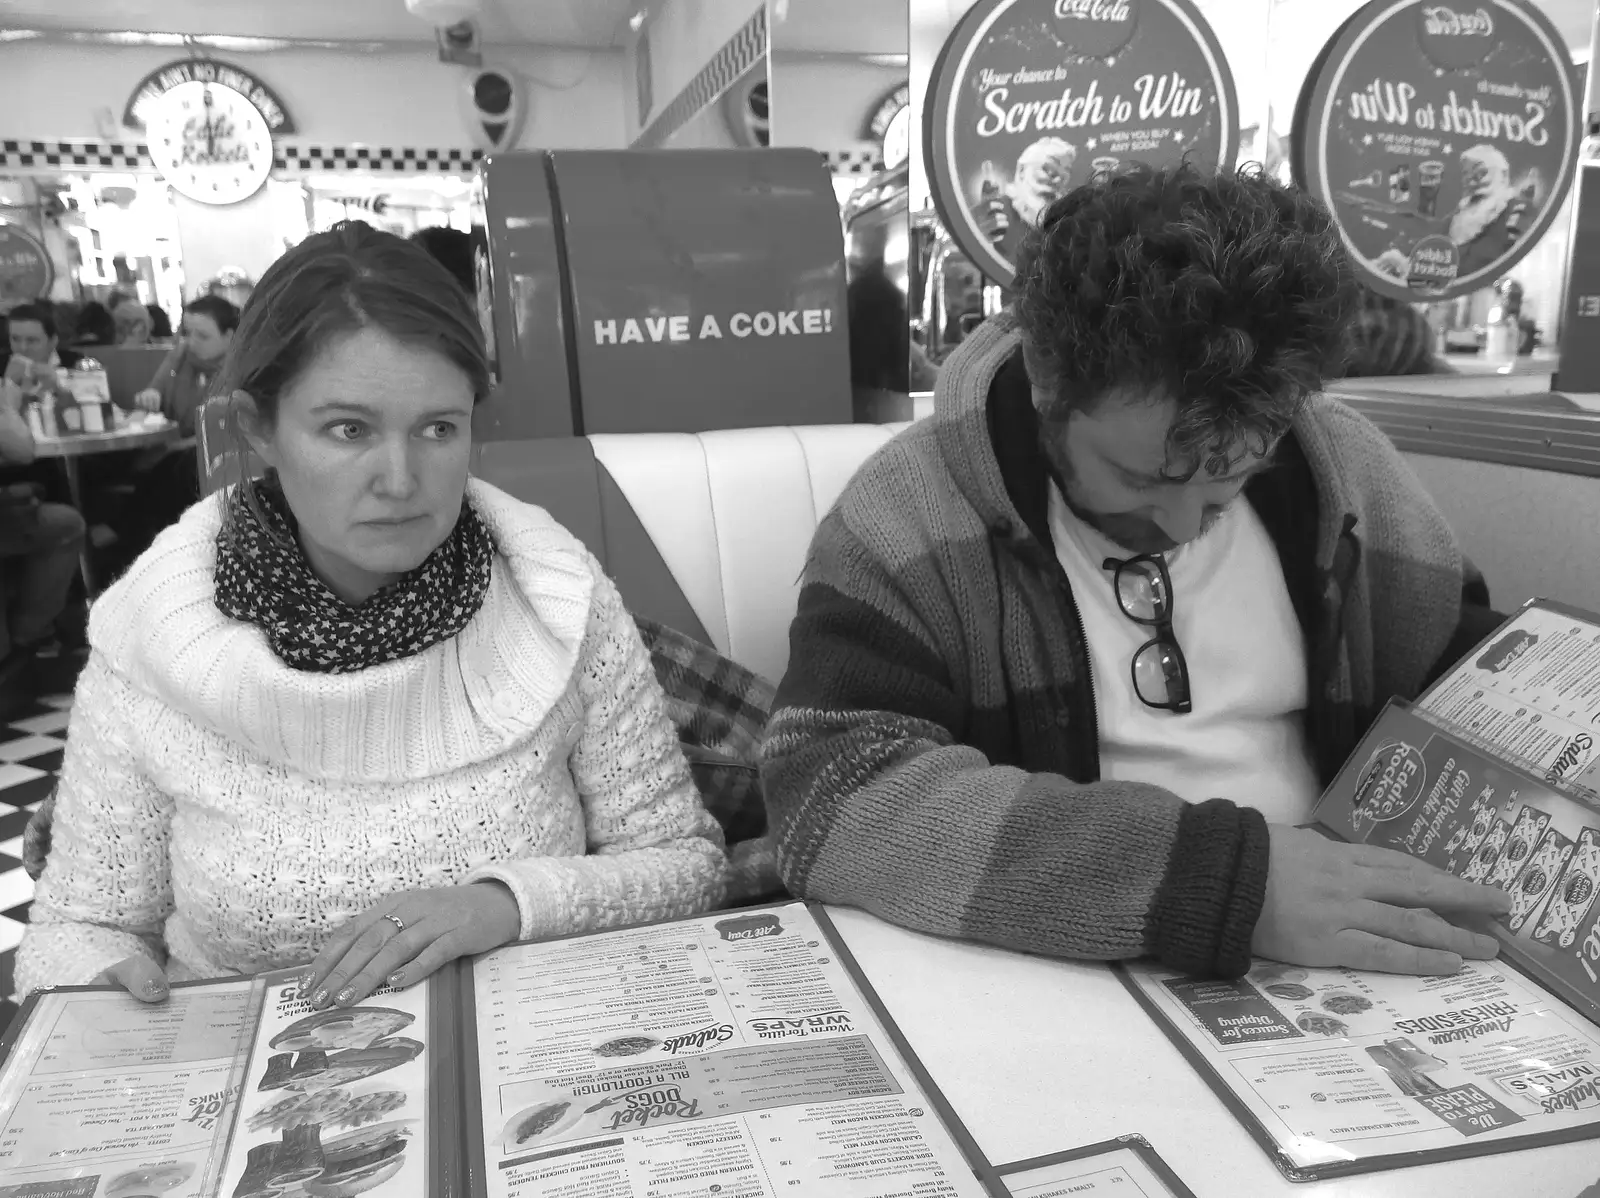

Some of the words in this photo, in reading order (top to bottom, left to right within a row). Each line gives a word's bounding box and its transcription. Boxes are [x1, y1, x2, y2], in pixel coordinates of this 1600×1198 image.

[979, 68, 1012, 92] Your
[1013, 66, 1054, 84] chance
[1055, 64, 1067, 81] to
[976, 79, 1104, 137] Scratch
[1108, 95, 1132, 124] to
[1133, 71, 1203, 120] Win
[1100, 131, 1130, 143] WHEN
[1130, 130, 1150, 140] YOU
[1151, 128, 1170, 138] BUY
[593, 316, 690, 345] HAVE
[698, 314, 723, 339] A
[729, 308, 833, 337] COKE!
[1364, 741, 1410, 820] Rocket's
[1382, 759, 1417, 813] Eddie
[1422, 758, 1456, 815] available
[1450, 770, 1470, 798] Gift
[1417, 797, 1459, 856] Vouchers
[1403, 813, 1429, 853] here!
[728, 929, 754, 941] Day
[754, 924, 776, 936] All
[276, 1000, 311, 1011] Meals
[1446, 1011, 1467, 1026] AND
[1460, 1001, 1517, 1024] FRIES
[752, 1015, 851, 1032] WRAPS
[1218, 1014, 1274, 1028] Dipping
[1395, 1014, 1455, 1034] SIDES
[758, 1027, 808, 1039] Tortilla
[810, 1024, 854, 1033] Warm
[1221, 1027, 1242, 1040] for
[1243, 1024, 1290, 1036] Sauces
[1427, 1016, 1515, 1045] American
[660, 1024, 734, 1054] Salads
[623, 1064, 654, 1072] Sausage
[544, 1077, 559, 1085] Dog
[577, 1076, 595, 1084] Dogs
[596, 1074, 623, 1082] Rocket
[655, 1075, 663, 1083] A
[667, 1070, 690, 1081] ALL
[572, 1075, 652, 1097] FOOTLONG!!
[625, 1088, 681, 1108] DOGS
[1423, 1087, 1488, 1113] PLEASE
[1466, 1100, 1497, 1114] AIM
[602, 1098, 703, 1131] Rocket
[869, 1113, 895, 1121] CHICKEN
[1443, 1109, 1464, 1120] TO
[1468, 1112, 1502, 1129] We
[1355, 1123, 1392, 1132] MILKSHAKES
[147, 1138, 171, 1146] COFFEE
[686, 1138, 714, 1147] CHICKEN
[715, 1134, 742, 1143] CHEEZY
[860, 1139, 879, 1147] PATTY
[901, 1134, 922, 1142] CAJUN
[570, 1164, 589, 1173] FRIED
[590, 1157, 625, 1169] SOUTHERN
[719, 1164, 754, 1174] SOUTHERN
[833, 1161, 869, 1170] SANDWICH
[539, 1168, 569, 1179] CHICKEN
[670, 1173, 698, 1183] CHICKEN
[507, 1175, 538, 1187] TENDERS
[564, 1183, 575, 1191] Hot
[648, 1178, 669, 1186] FILLET
[912, 1181, 935, 1189] toasted
[66, 1187, 85, 1197] Red
[913, 1187, 937, 1195] Brown,
[937, 1185, 954, 1193] Nutty
[1073, 1183, 1095, 1193] MALTS
